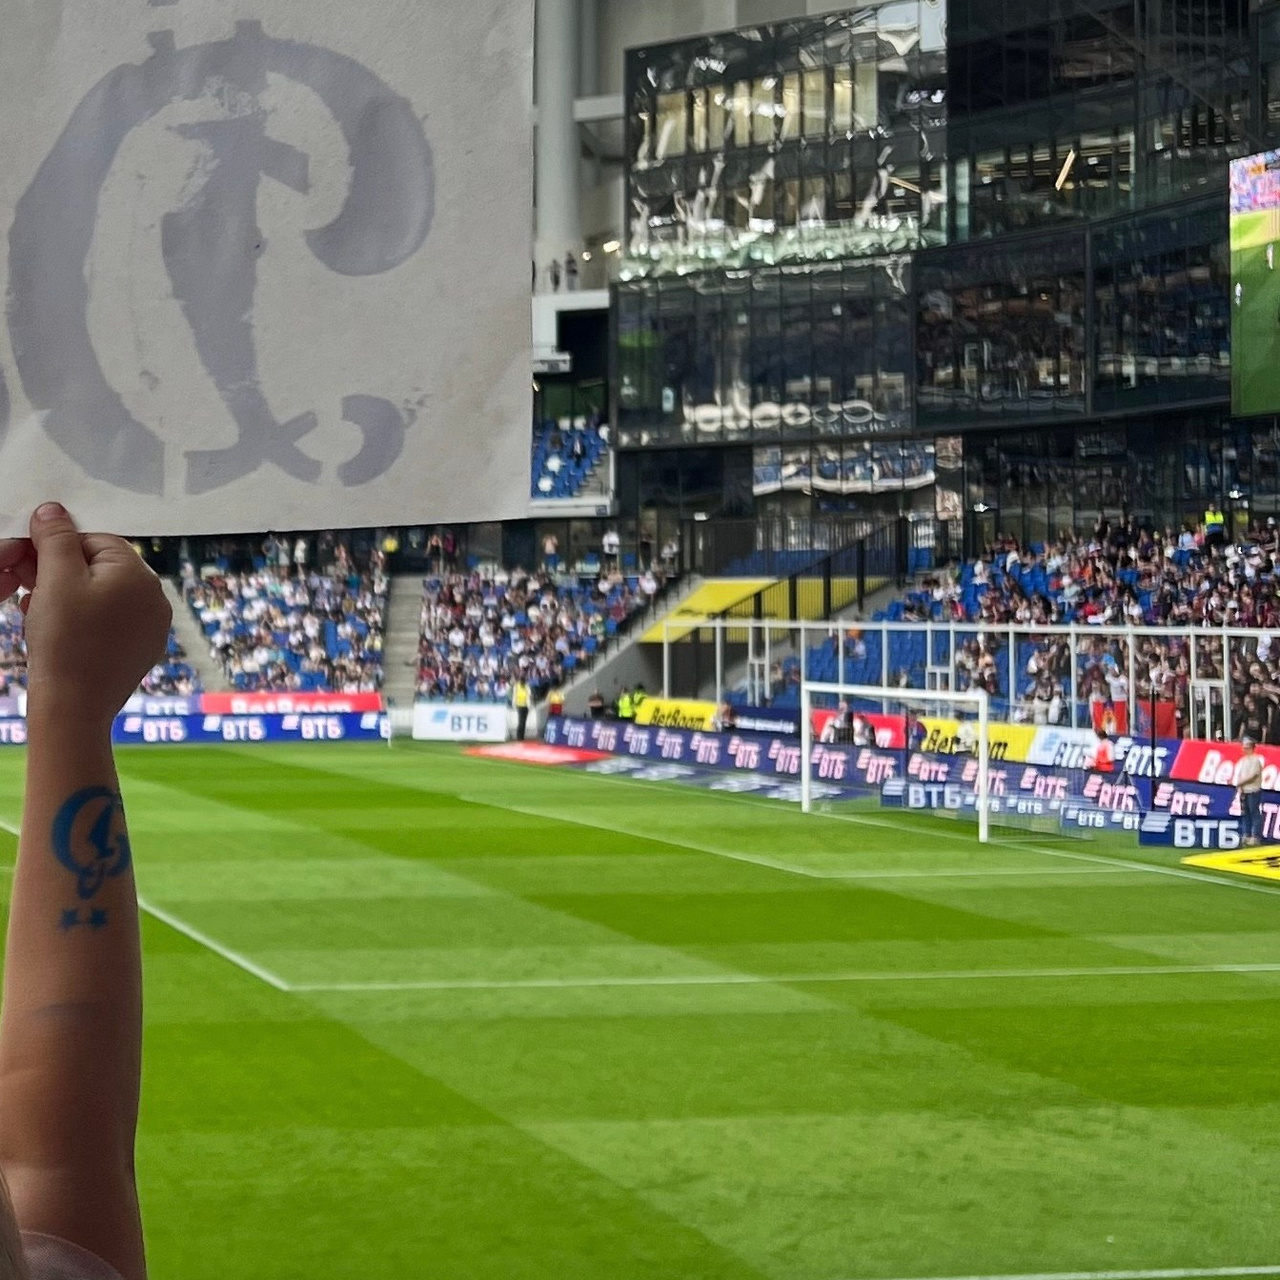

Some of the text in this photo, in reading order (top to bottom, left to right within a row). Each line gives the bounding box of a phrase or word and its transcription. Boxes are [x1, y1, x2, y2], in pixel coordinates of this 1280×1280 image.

[143, 718, 186, 742] ВТБ
[222, 717, 265, 740] ВТБ
[301, 715, 344, 739] ВТБ
[451, 714, 488, 732] ВТБ
[629, 730, 650, 755] ВТБ
[734, 743, 760, 769] ВТБ
[908, 782, 962, 809] ВТБ
[1174, 818, 1240, 849] ВТБ
